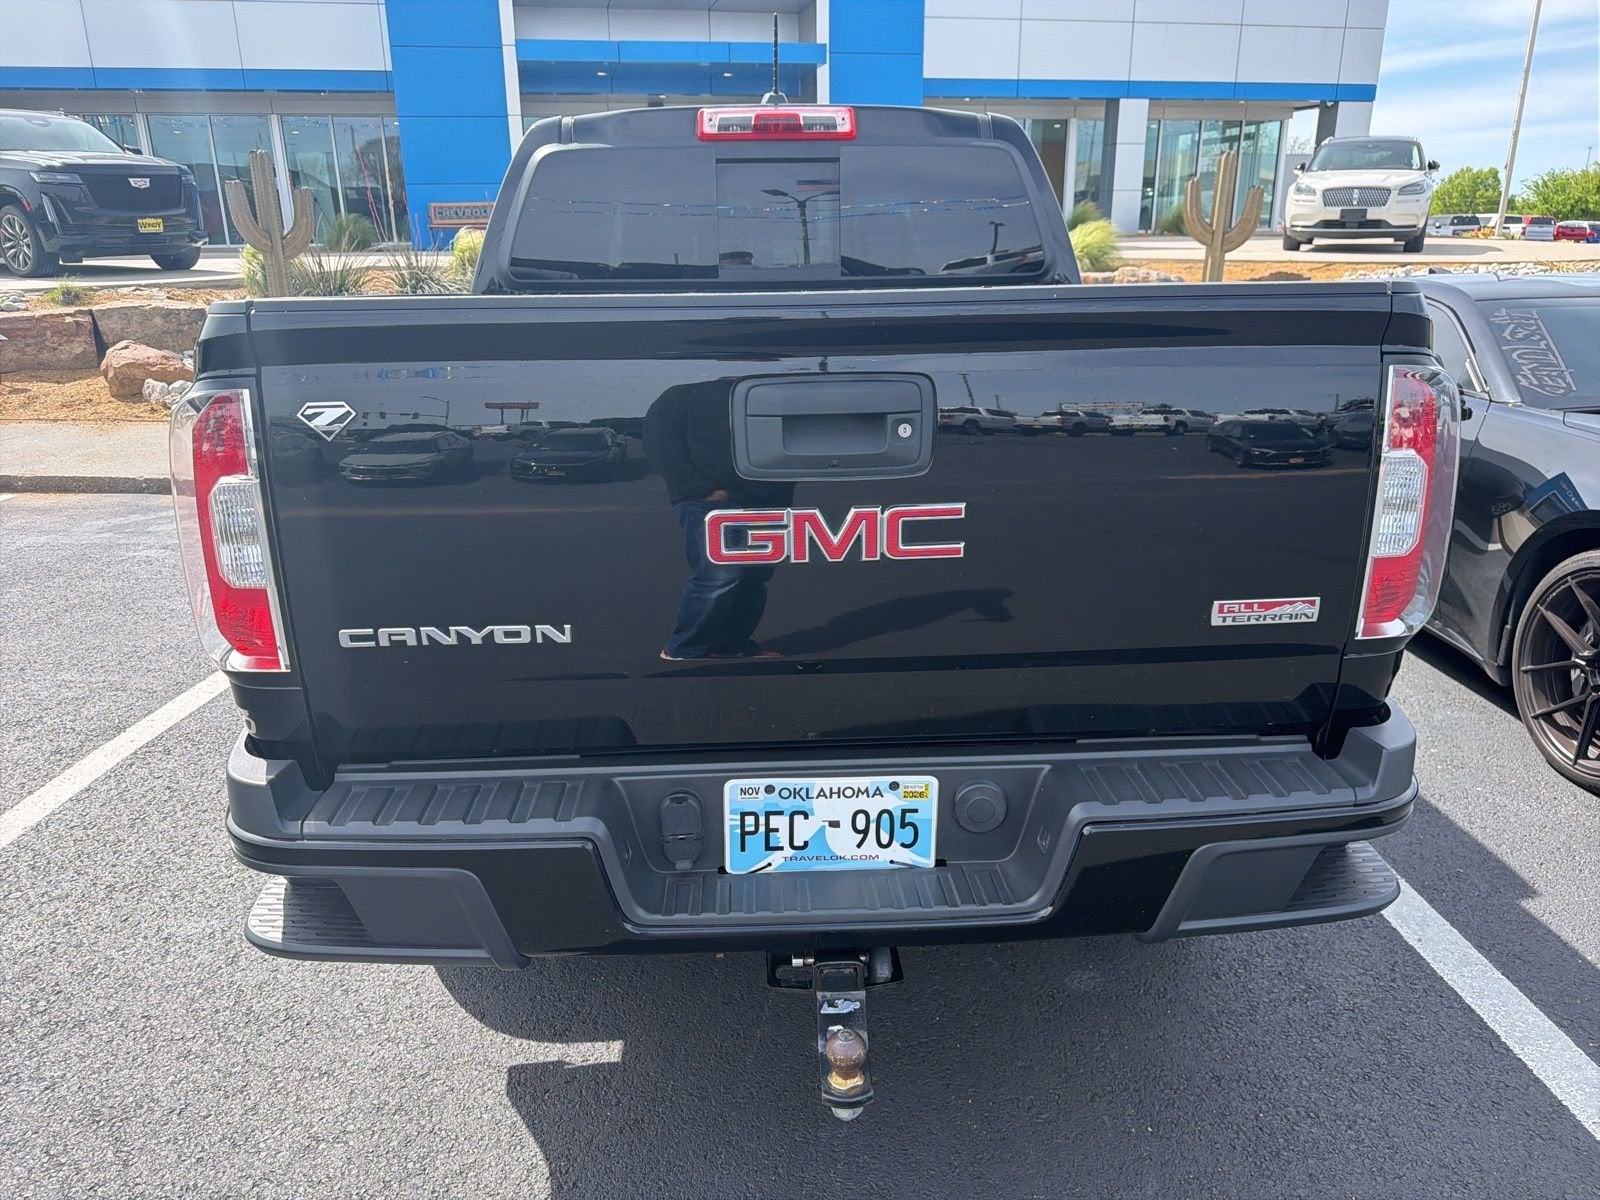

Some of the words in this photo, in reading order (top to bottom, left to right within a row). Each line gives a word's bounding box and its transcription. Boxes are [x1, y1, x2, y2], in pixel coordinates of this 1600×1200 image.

[704, 503, 966, 564] GMC
[1223, 603, 1266, 613] ALL
[1217, 612, 1315, 623] TERRAIN
[338, 624, 571, 648] CANYON
[739, 786, 761, 797] NOV
[778, 785, 884, 801] OKLAHOMA
[903, 790, 925, 799] 2026
[739, 810, 809, 852] PEC
[851, 808, 919, 849] 905
[781, 854, 880, 862] TRAVELOK.COM
